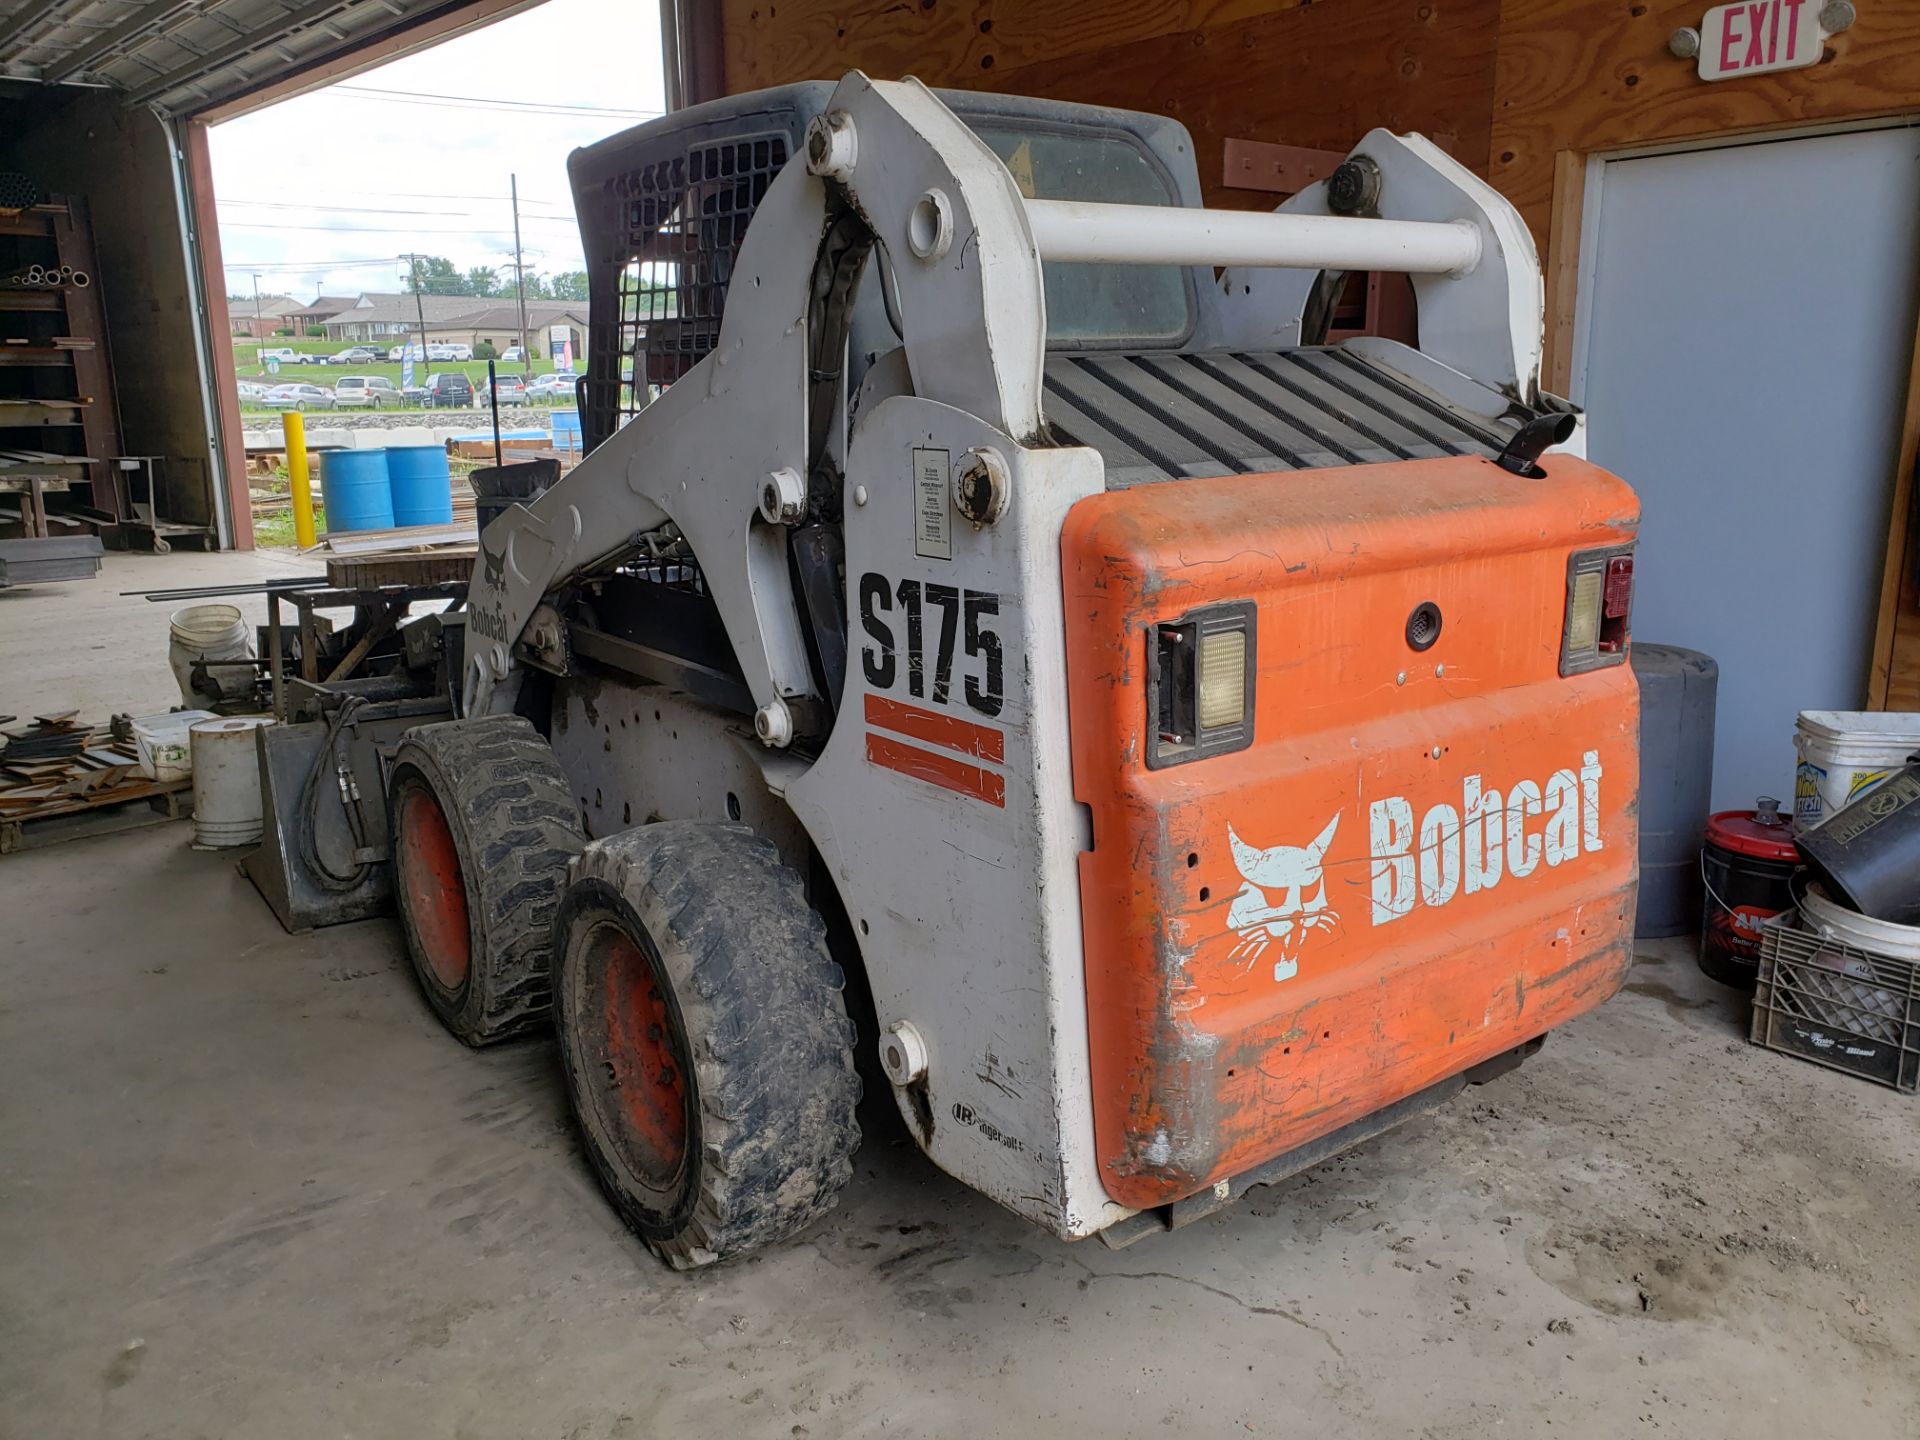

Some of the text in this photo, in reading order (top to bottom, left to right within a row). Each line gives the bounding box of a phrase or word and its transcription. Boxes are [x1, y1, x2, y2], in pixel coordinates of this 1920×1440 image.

[1719, 0, 1806, 71] EXIT
[469, 601, 509, 645] Bobcat
[859, 572, 1004, 718] S175
[1369, 750, 1603, 927] Bobcat
